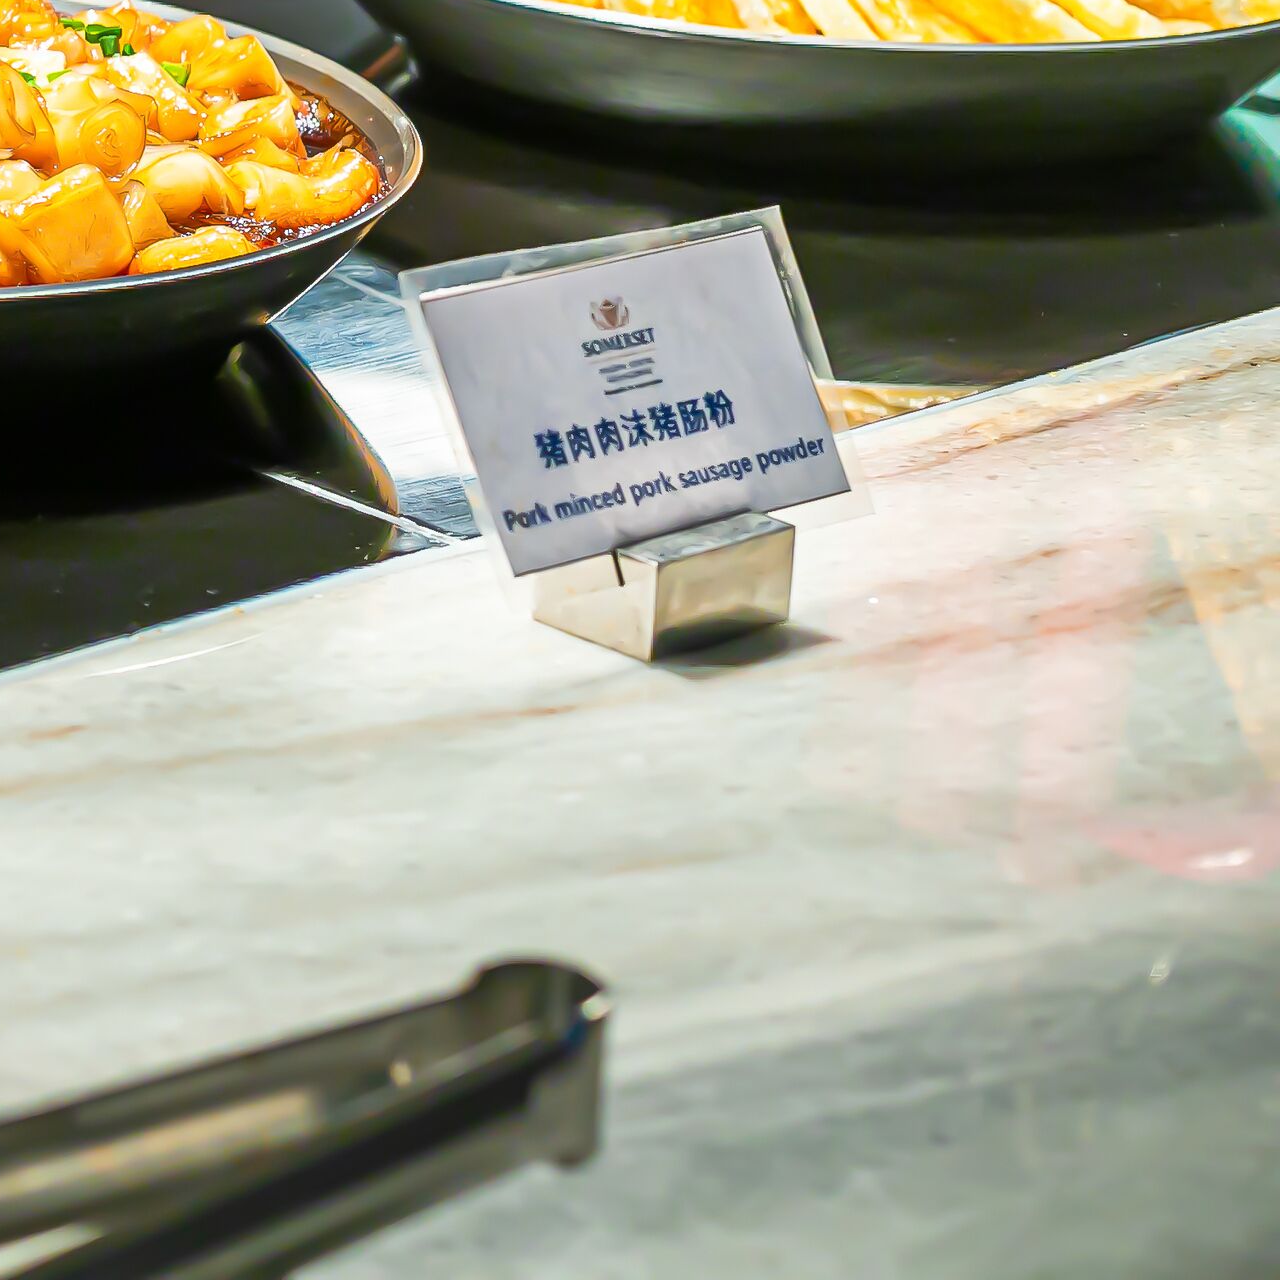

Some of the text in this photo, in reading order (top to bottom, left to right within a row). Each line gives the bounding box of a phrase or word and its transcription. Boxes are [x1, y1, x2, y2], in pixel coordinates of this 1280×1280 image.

[502, 436, 825, 533] Pork minced pork sausage powder
